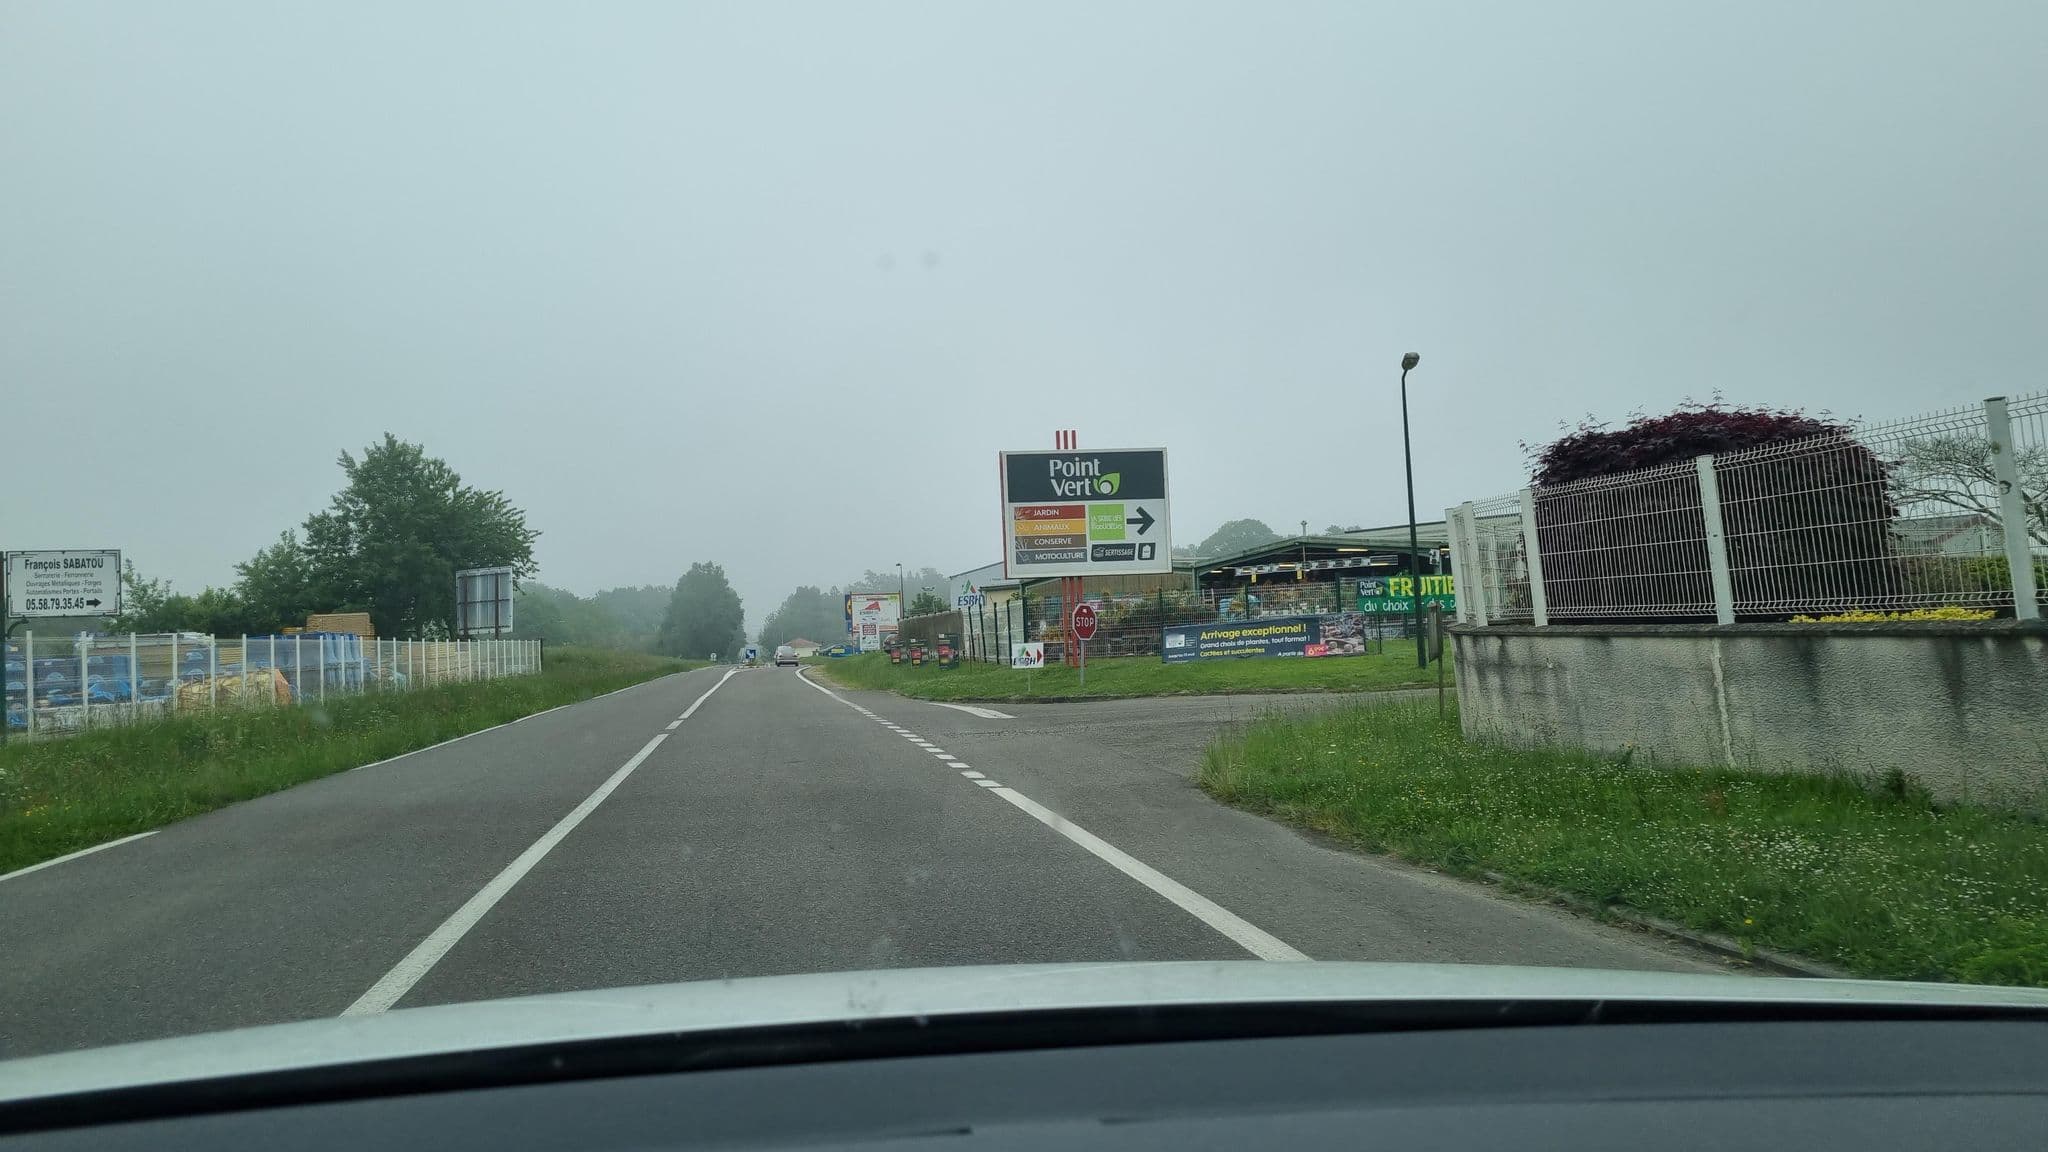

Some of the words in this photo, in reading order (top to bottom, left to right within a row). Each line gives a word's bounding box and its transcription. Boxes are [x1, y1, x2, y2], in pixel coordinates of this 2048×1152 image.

[1049, 457, 1101, 477] Point
[1051, 478, 1092, 497] Vert
[1033, 508, 1060, 518] JARDIN
[1033, 522, 1070, 532] ANIMAUX
[1034, 537, 1073, 546] CONSERVE
[1035, 551, 1086, 561] MOTOCULTURE
[1104, 547, 1135, 557] SERTISSAGE
[24, 558, 61, 571] François
[63, 557, 104, 569] SABATOU
[1359, 581, 1377, 589] Point
[1360, 588, 1374, 596] Vert
[26, 597, 85, 611] 05.58.79.35.45
[957, 594, 982, 607] ESBH
[1364, 600, 1377, 612] du
[1382, 599, 1409, 612] choix
[1075, 617, 1094, 627] STOP
[1200, 628, 1241, 641] Arrivage
[1241, 624, 1302, 637] exceptionnel
[1200, 641, 1219, 649] Grand
[1220, 640, 1236, 648] choix
[1236, 639, 1245, 647] de
[1272, 636, 1283, 644] tout
[1284, 635, 1306, 643] format
[1231, 647, 1265, 656] succulentes
[1013, 656, 1036, 666] ESBH
